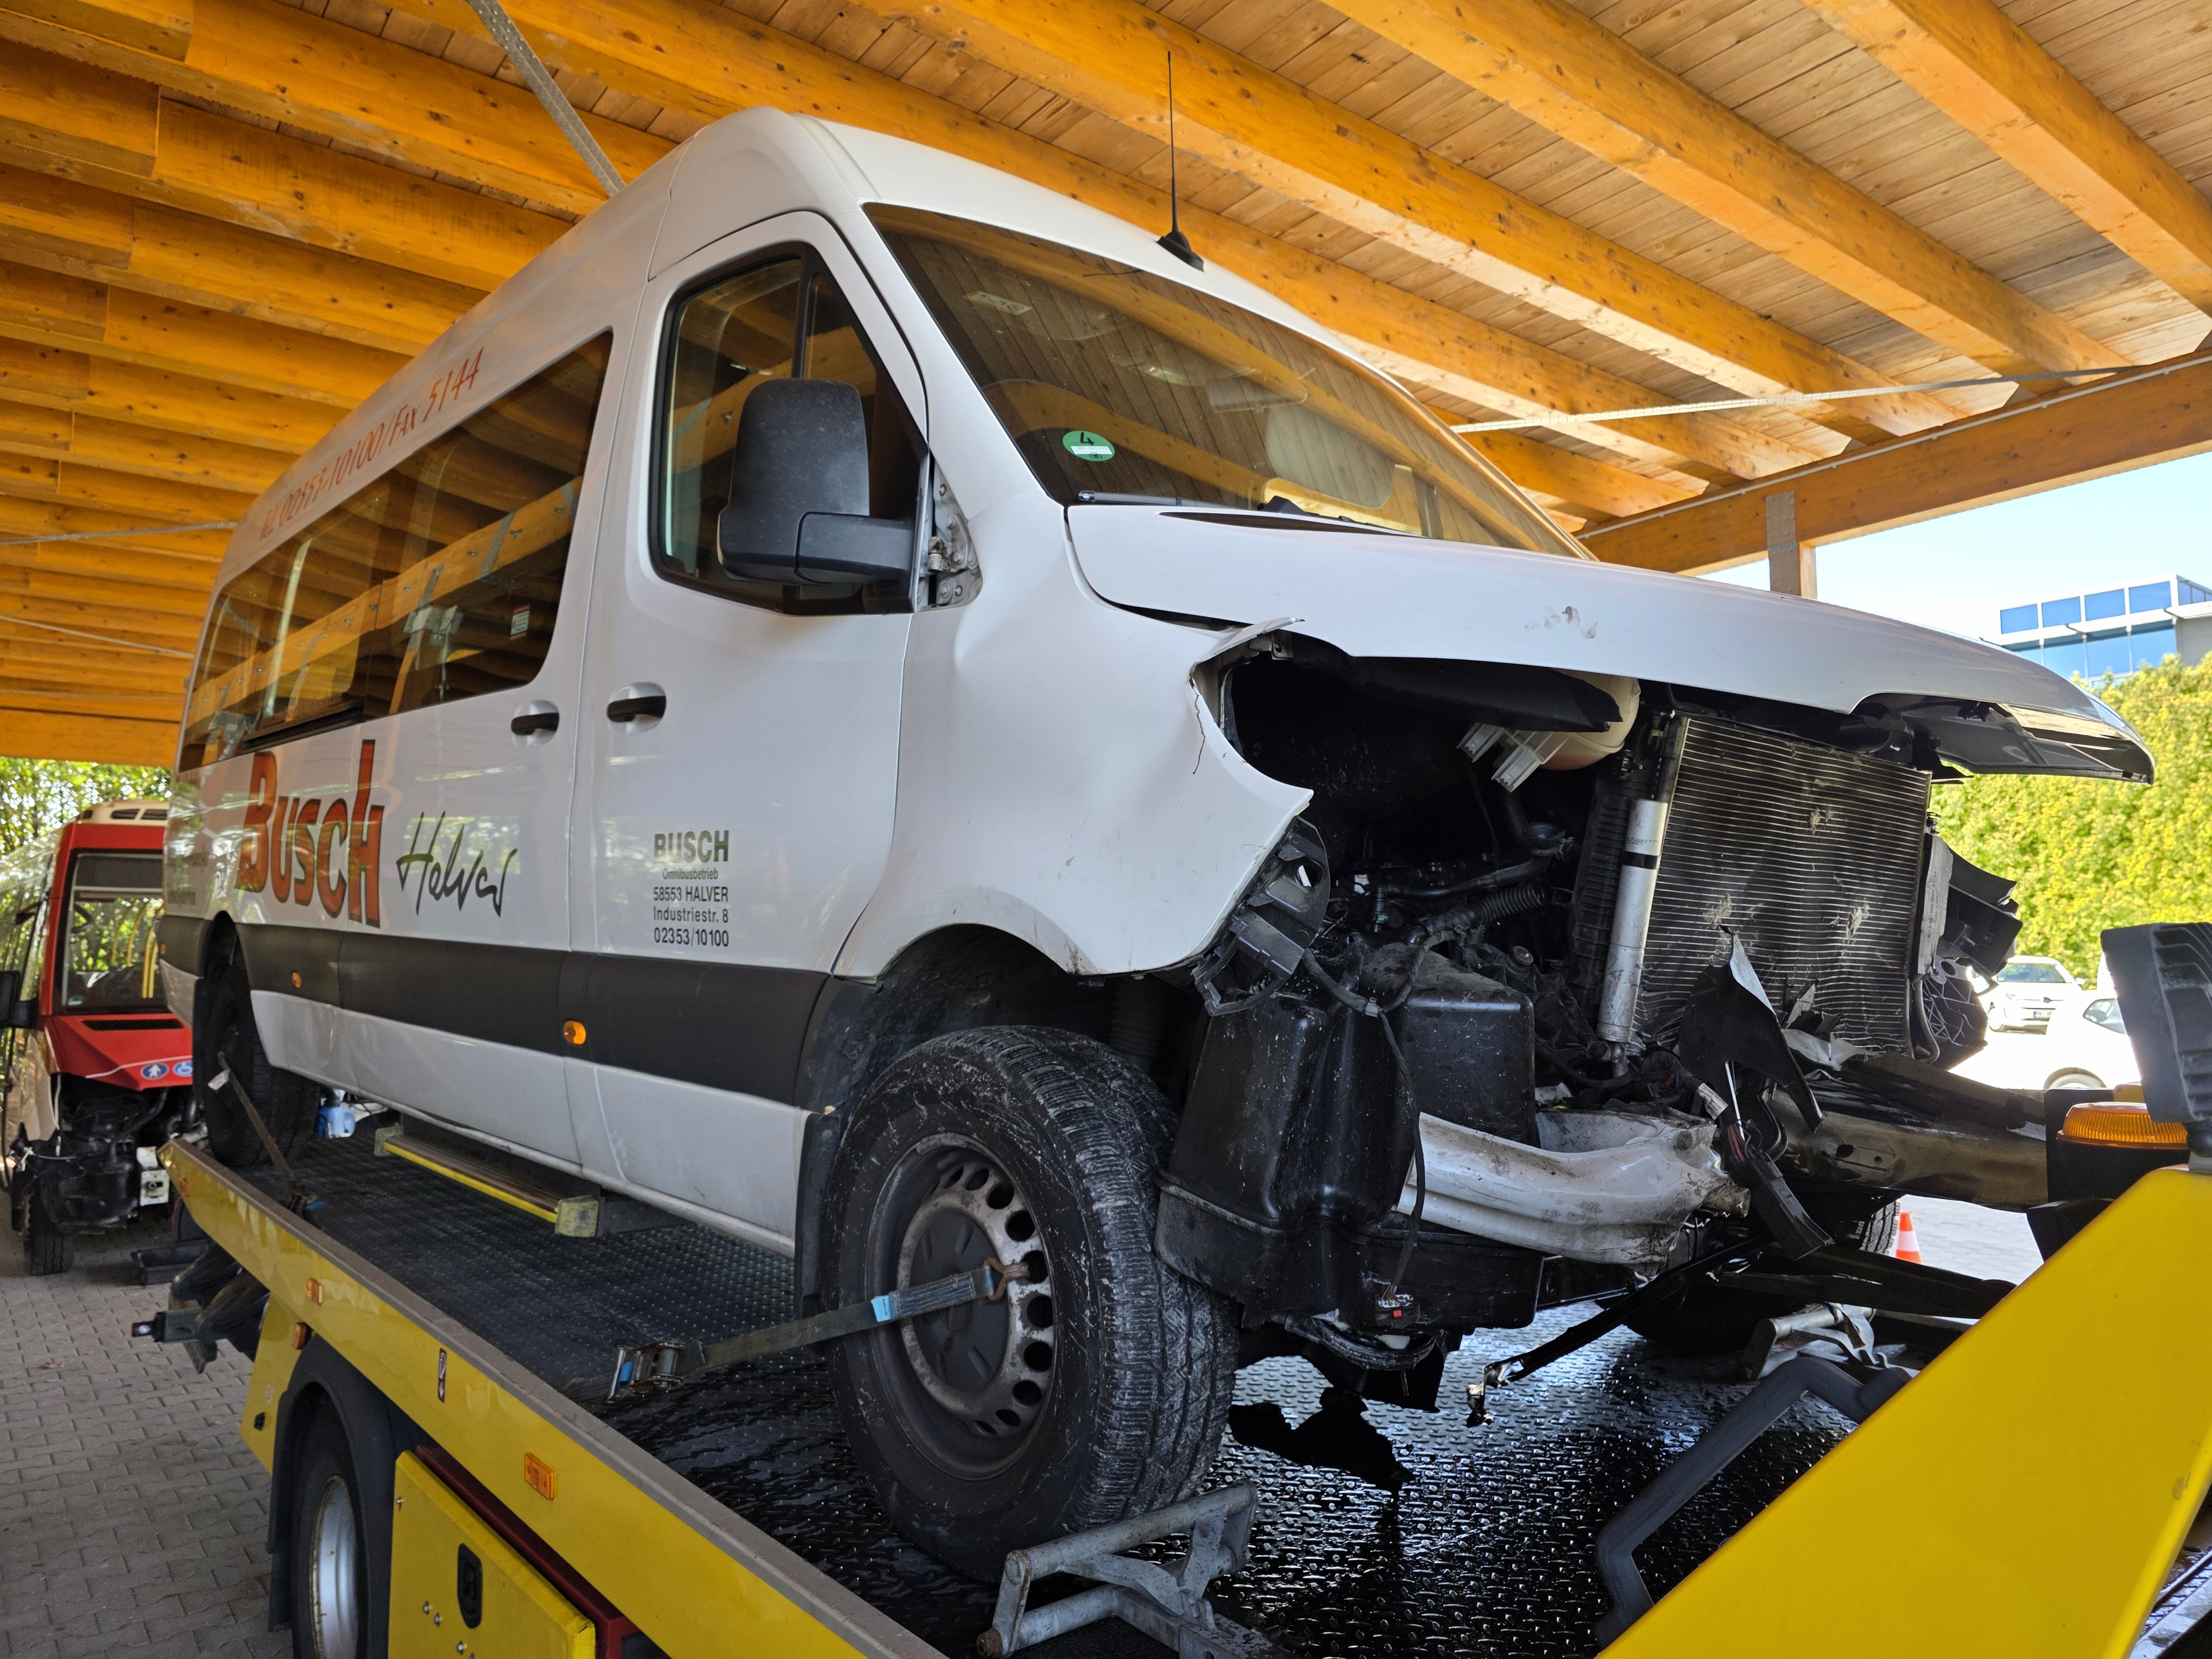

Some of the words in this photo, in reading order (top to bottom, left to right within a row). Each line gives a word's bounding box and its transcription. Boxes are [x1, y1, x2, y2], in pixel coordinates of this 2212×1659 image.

[422, 346, 484, 423] 5144
[1080, 432, 1094, 446] 4
[654, 830, 729, 863] BUSCH
[662, 868, 718, 880] Omnibusbetrieb
[653, 886, 682, 901] 58553
[685, 886, 729, 902] HALVER
[653, 906, 719, 923] Industriestr.
[722, 909, 729, 924] 8
